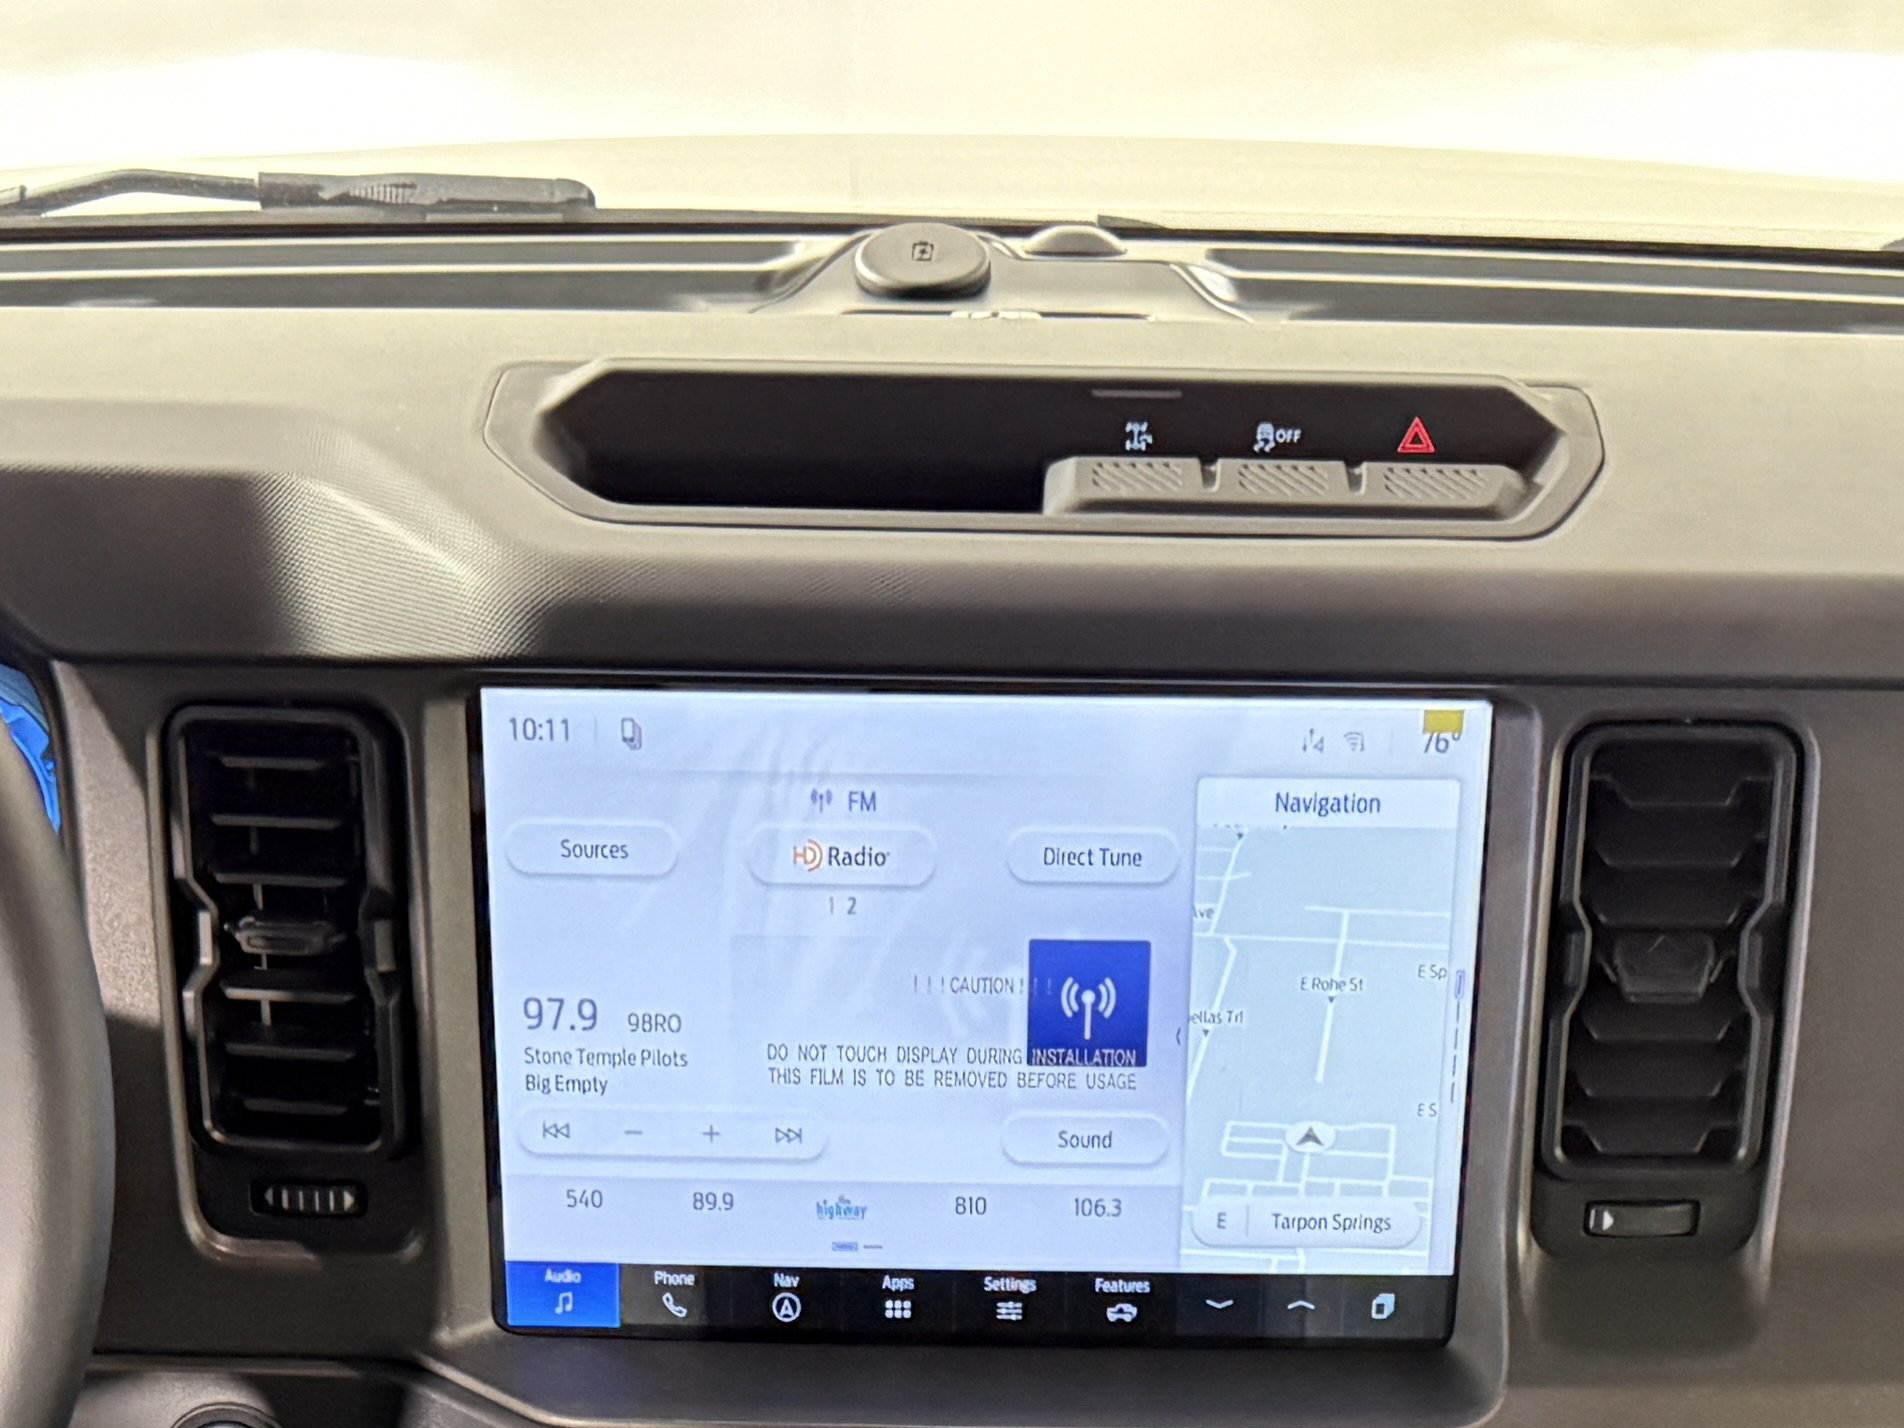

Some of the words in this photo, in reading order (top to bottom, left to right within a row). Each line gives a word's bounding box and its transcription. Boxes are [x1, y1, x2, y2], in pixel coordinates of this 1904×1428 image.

[1276, 429, 1302, 444] OFF
[508, 717, 571, 742] 10:11
[847, 791, 878, 812] FM
[1274, 790, 1382, 816] Navigation
[560, 839, 630, 861] Sources
[1042, 846, 1094, 868] Direct
[1099, 848, 1143, 868] Tune
[846, 897, 857, 916] 2
[949, 976, 1015, 995] CAUTION
[1349, 978, 1364, 992] St
[523, 997, 599, 1032] 97.9
[626, 1013, 682, 1034] 98RO
[523, 1046, 573, 1067] Stone
[576, 1047, 638, 1070] Temple
[641, 1049, 689, 1069] Pilots
[767, 1043, 789, 1062] DO
[797, 1044, 829, 1062] NOT
[836, 1044, 888, 1064] TOUCH
[896, 1046, 959, 1064] DISPLAY
[966, 1047, 1023, 1066] DURING
[1031, 1048, 1137, 1067] INSTALLATION
[525, 1073, 551, 1096] Big
[554, 1074, 609, 1097] Empty
[767, 1068, 802, 1086] THIS
[809, 1068, 845, 1087] FILM
[853, 1069, 867, 1087] IS
[876, 1069, 896, 1087] TO
[904, 1069, 926, 1088] BE
[933, 1070, 1008, 1089] REMOVED
[1017, 1071, 1082, 1090] BEFORE
[1085, 1072, 1137, 1090] USAGE
[1057, 1130, 1114, 1149] Sound
[565, 1189, 604, 1209] 540
[692, 1191, 735, 1212] 89.9
[953, 1196, 988, 1216] 810
[1073, 1198, 1123, 1218] 106.3
[816, 1200, 868, 1221] highway
[1216, 1213, 1227, 1229] E
[1271, 1213, 1330, 1234] Tarpon
[1332, 1214, 1392, 1235] Springs
[544, 1267, 582, 1284] Audio
[653, 1271, 696, 1287] Phone
[773, 1273, 801, 1289] Nav
[882, 1275, 916, 1293] Apps
[982, 1276, 1037, 1294] Settings
[1094, 1278, 1152, 1295] Features
